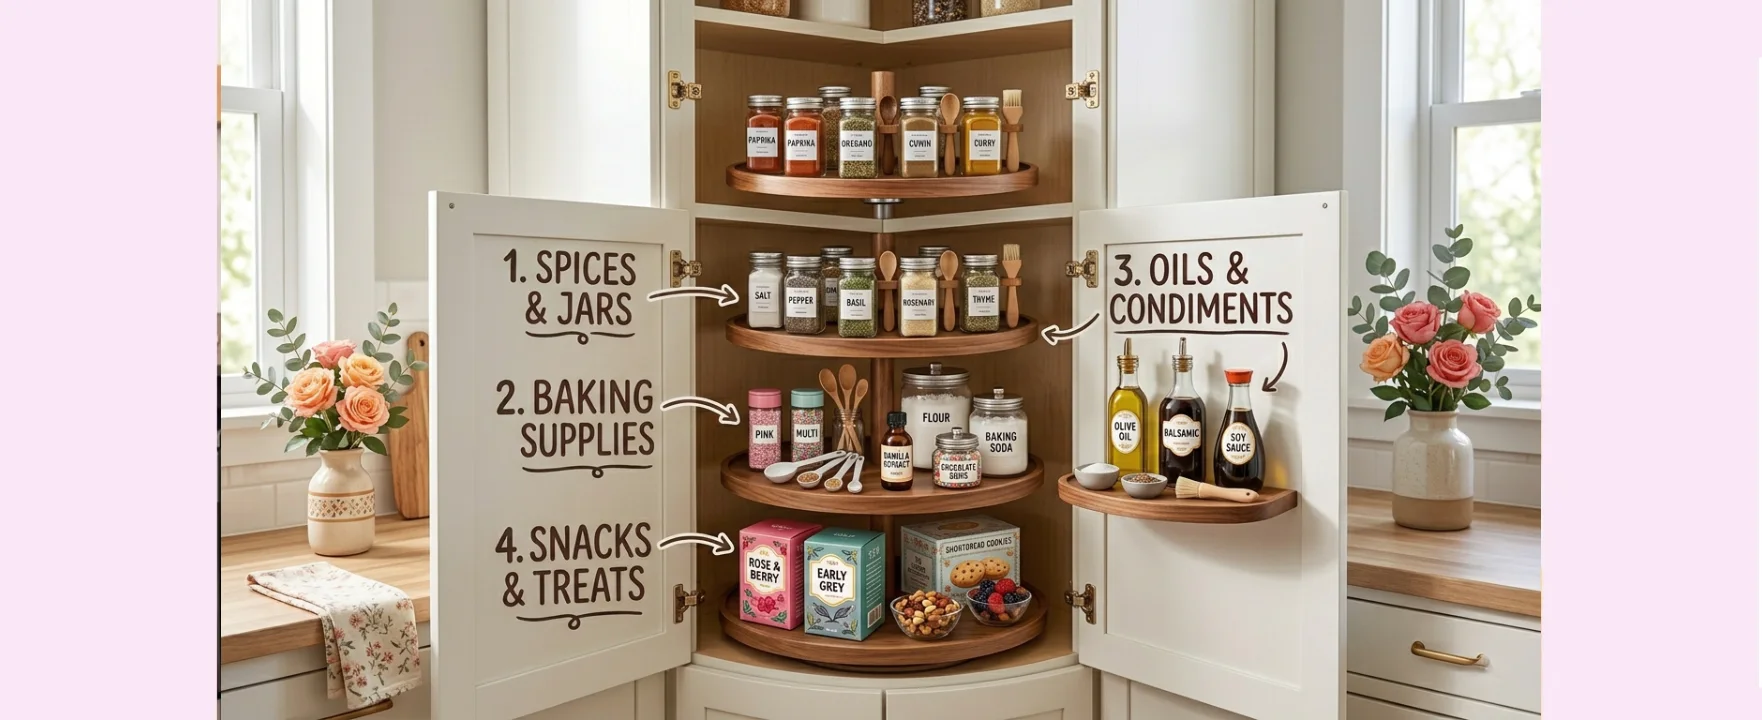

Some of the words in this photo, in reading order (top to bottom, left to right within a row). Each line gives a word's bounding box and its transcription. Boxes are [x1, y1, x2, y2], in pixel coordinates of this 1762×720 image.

[748, 136, 776, 144] PAPRIKA
[787, 139, 816, 147] PAPRIKA
[974, 139, 996, 147] CURRY
[503, 248, 527, 283] 1.
[536, 250, 636, 286] SPICES
[1114, 254, 1142, 287] 3.
[1150, 252, 1214, 286] OILS
[1226, 250, 1249, 286] &
[754, 291, 772, 300] SALT
[788, 296, 814, 304] PEPPER
[972, 294, 996, 304] THYME
[525, 290, 548, 325] &
[557, 292, 632, 326] JARS
[846, 298, 866, 307] BASIL
[1110, 291, 1294, 324] CONDIMENTS
[496, 379, 525, 416] 2.
[534, 379, 654, 415] BAKING
[922, 412, 950, 423] FLOUR
[1114, 421, 1136, 432] OLIVE
[755, 430, 774, 439] PINK
[796, 428, 818, 438] MULTI
[985, 431, 1017, 442] BAKING
[1118, 432, 1132, 441] OIL
[1164, 428, 1200, 438] BALSAMIC
[1230, 432, 1247, 442] SOY
[520, 421, 654, 458] SUPPLIES
[990, 442, 1013, 453] SODA
[1226, 442, 1251, 452] SAUCE
[495, 526, 524, 564] 4.
[530, 522, 652, 562] SNACKS
[986, 536, 1012, 548] COOKIES
[748, 557, 771, 570] ROSE
[773, 562, 780, 572] &
[750, 570, 780, 584] BERRY
[817, 568, 848, 581] EARLY
[502, 572, 526, 608] &
[532, 565, 645, 606] TREATS
[819, 580, 845, 593] GREY
